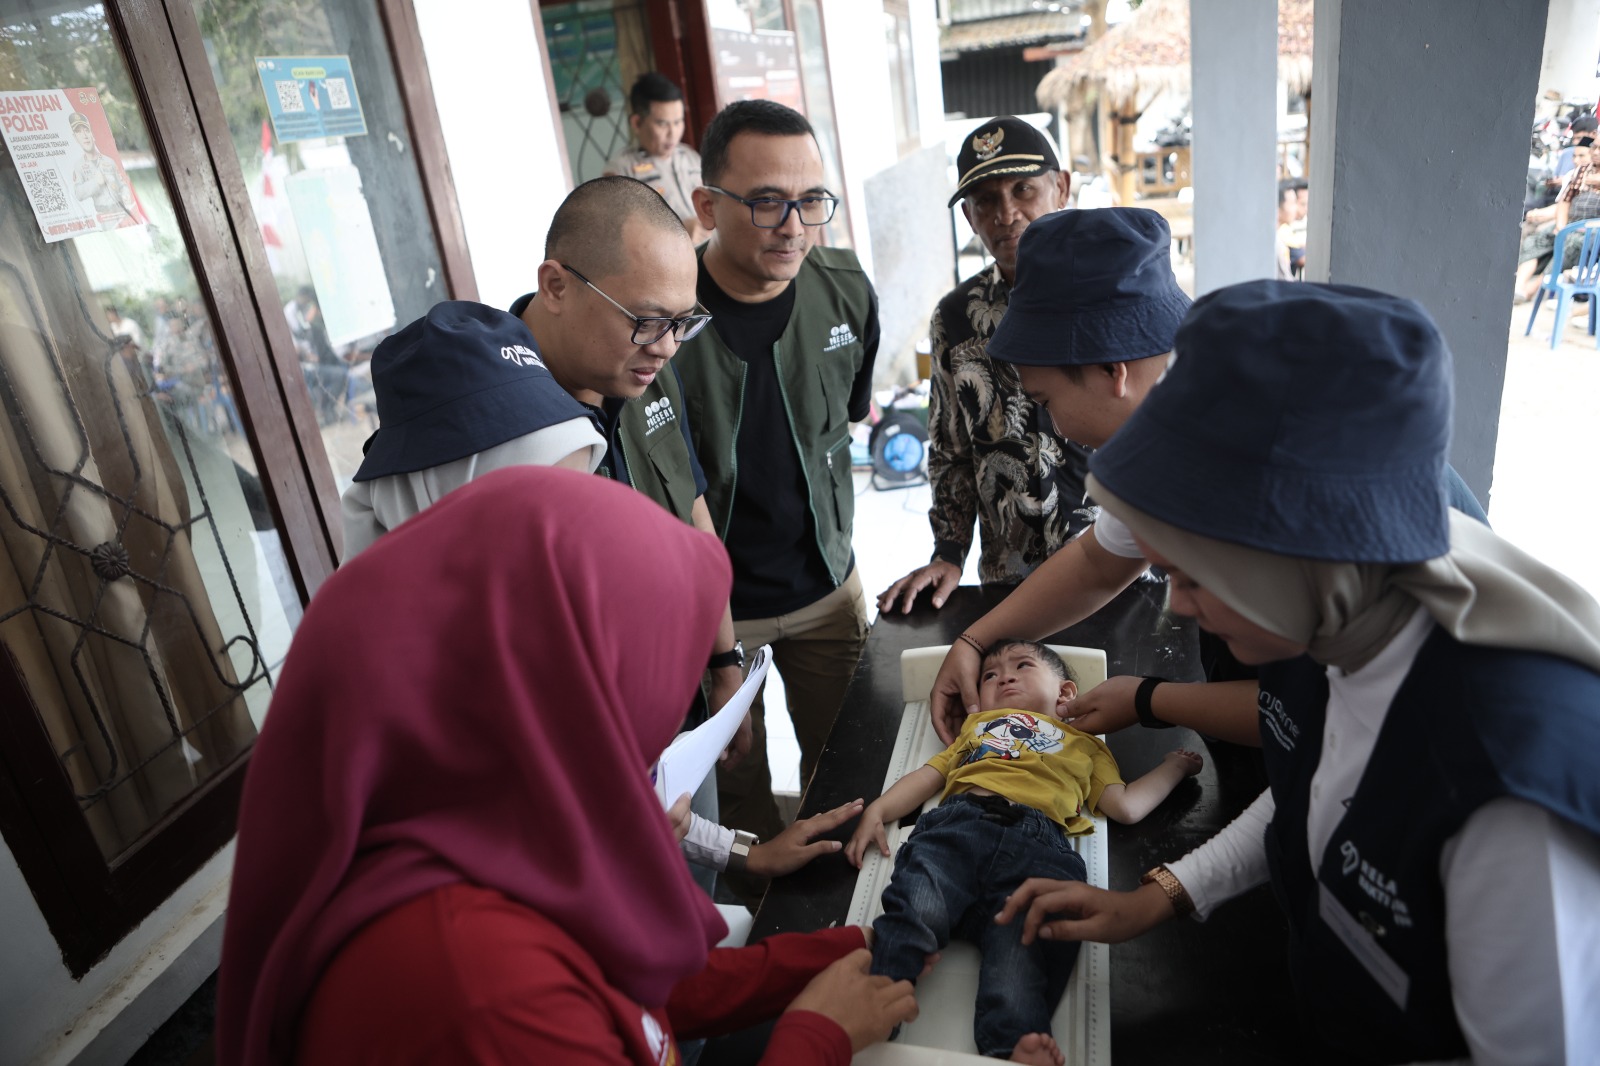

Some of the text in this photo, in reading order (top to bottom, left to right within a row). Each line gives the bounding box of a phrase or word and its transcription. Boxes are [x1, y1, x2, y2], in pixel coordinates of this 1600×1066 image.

[0, 94, 62, 114] BANTUAN
[1, 114, 48, 133] POLISI
[646, 406, 674, 428] PRESERV
